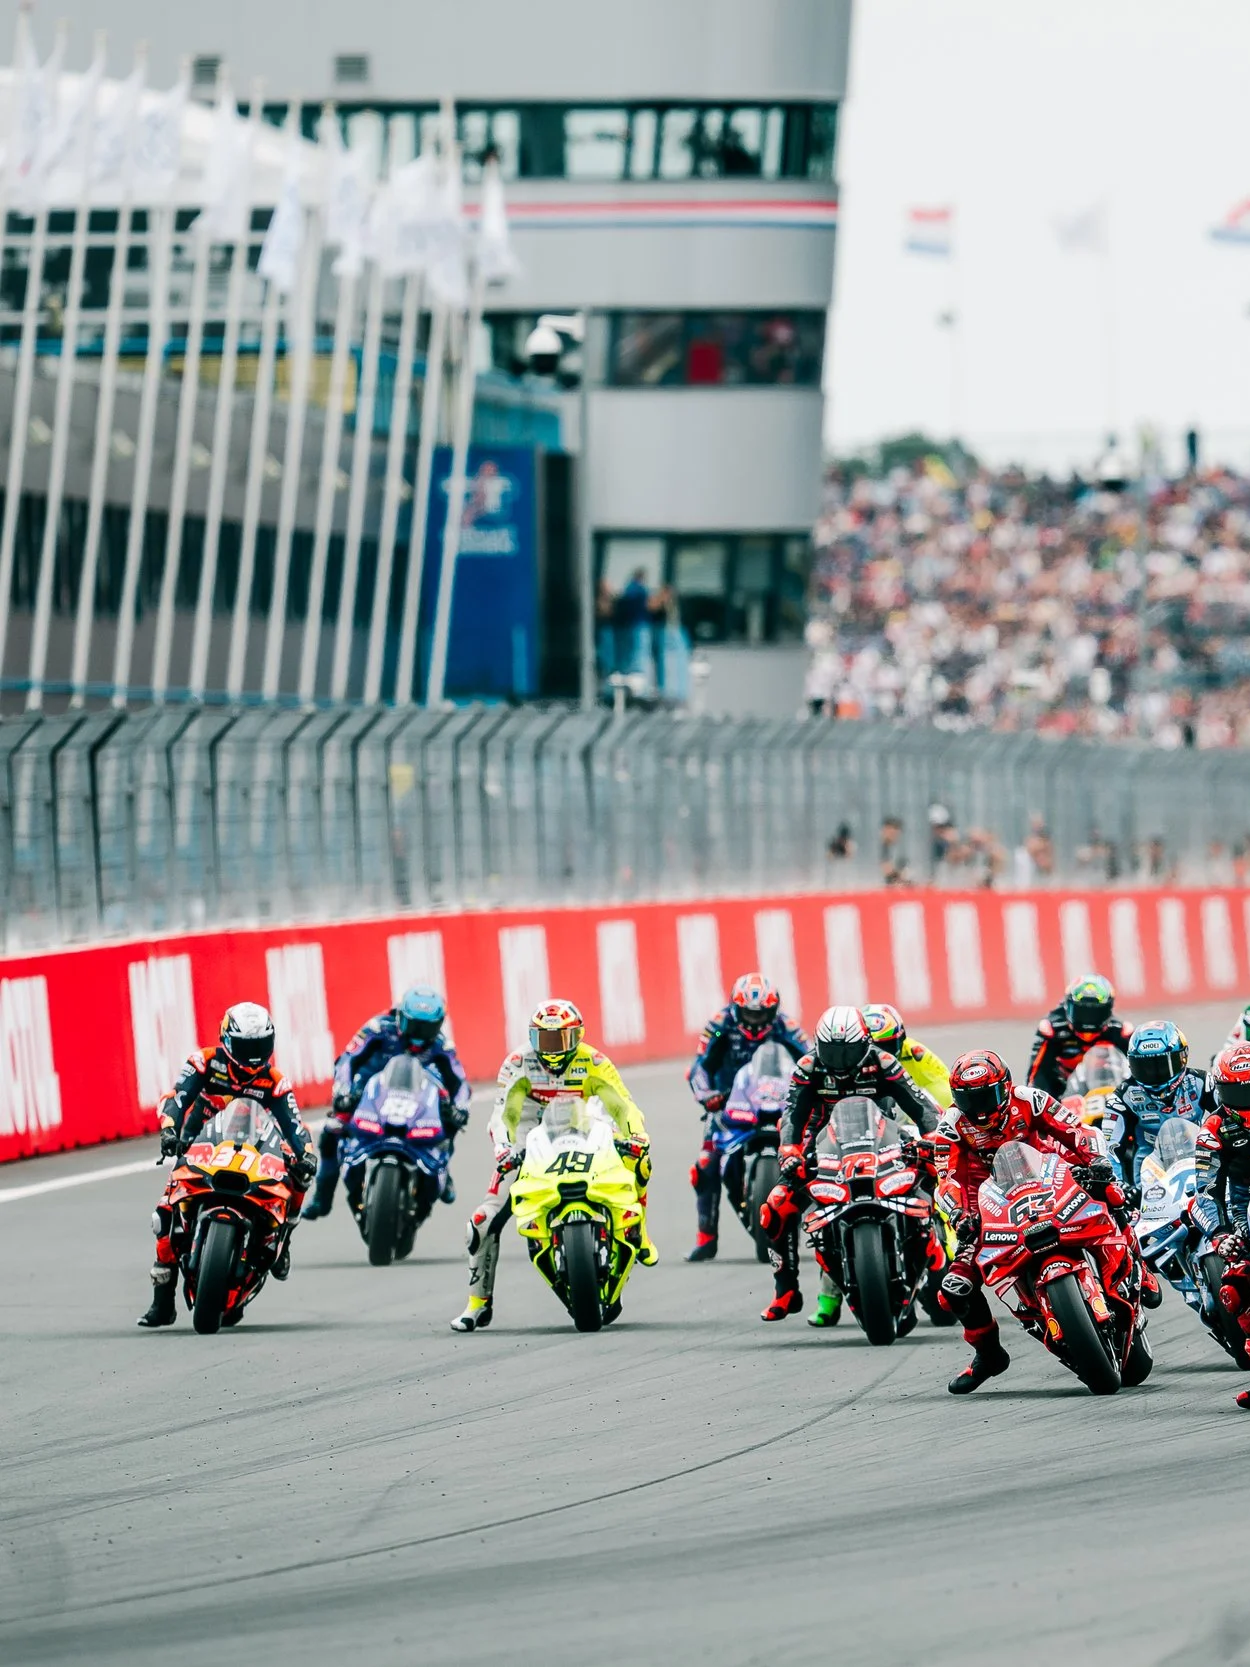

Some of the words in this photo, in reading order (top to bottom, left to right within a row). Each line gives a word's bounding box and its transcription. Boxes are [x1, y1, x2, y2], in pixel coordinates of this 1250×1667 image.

[210, 1145, 257, 1172] 37
[545, 1151, 594, 1176] 49
[842, 1152, 878, 1180] 72
[1056, 1192, 1086, 1220] Lenovo
[985, 1232, 1018, 1241] Lenovo
[989, 1249, 1001, 1260] TIM
[1041, 1262, 1070, 1281] Lenovo
